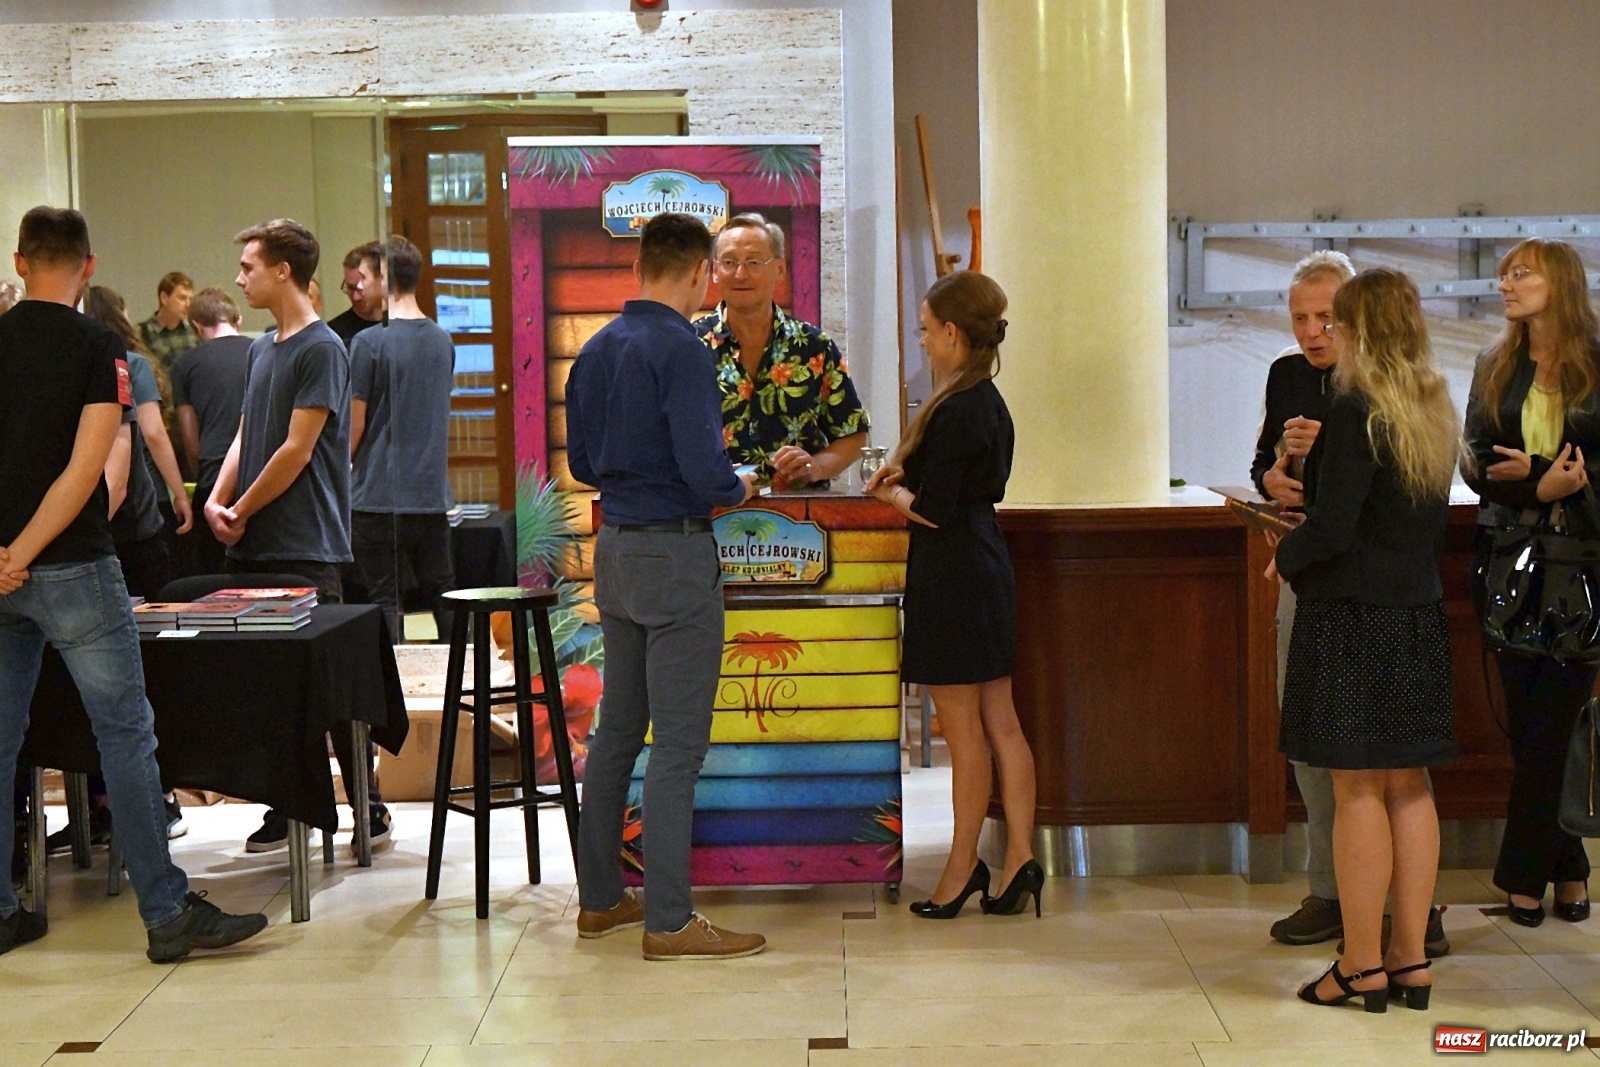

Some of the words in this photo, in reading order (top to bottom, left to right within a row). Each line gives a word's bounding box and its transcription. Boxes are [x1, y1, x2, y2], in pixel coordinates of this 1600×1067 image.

[608, 202, 660, 217] WOJCIECH
[665, 202, 725, 216] CEJROWSKI
[721, 545, 745, 558] ECH
[750, 545, 821, 562] CEJROWSKI
